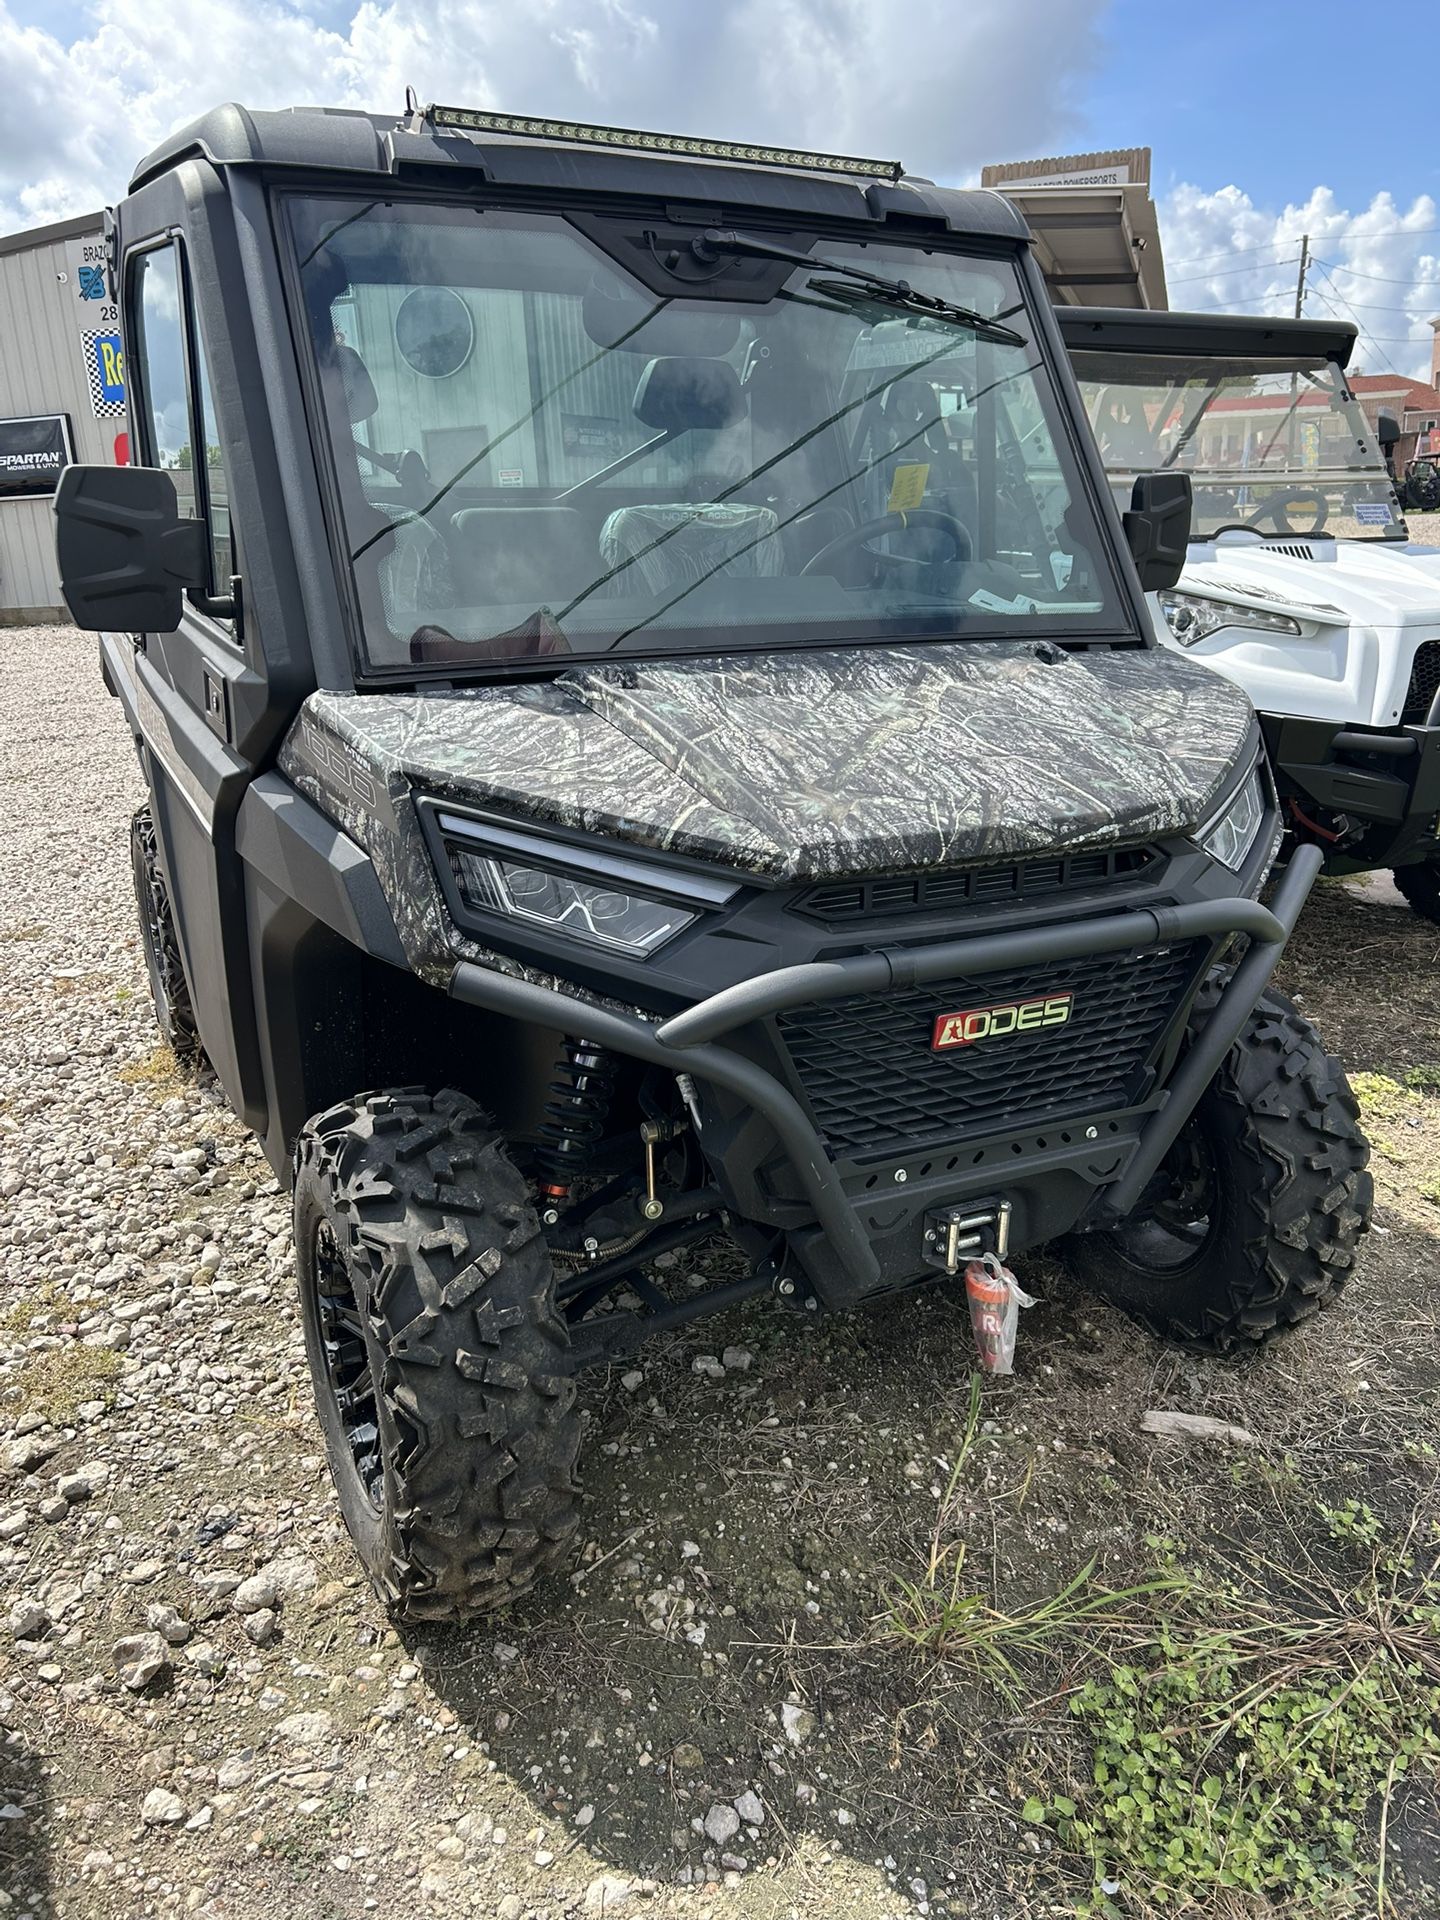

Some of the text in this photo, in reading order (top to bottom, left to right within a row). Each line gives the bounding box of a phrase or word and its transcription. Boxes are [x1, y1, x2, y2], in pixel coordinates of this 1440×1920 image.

[100, 306, 118, 321] 28
[0, 451, 59, 466] SPARTAN
[6, 463, 35, 471] MOWERS
[938, 996, 1071, 1046] AODES
